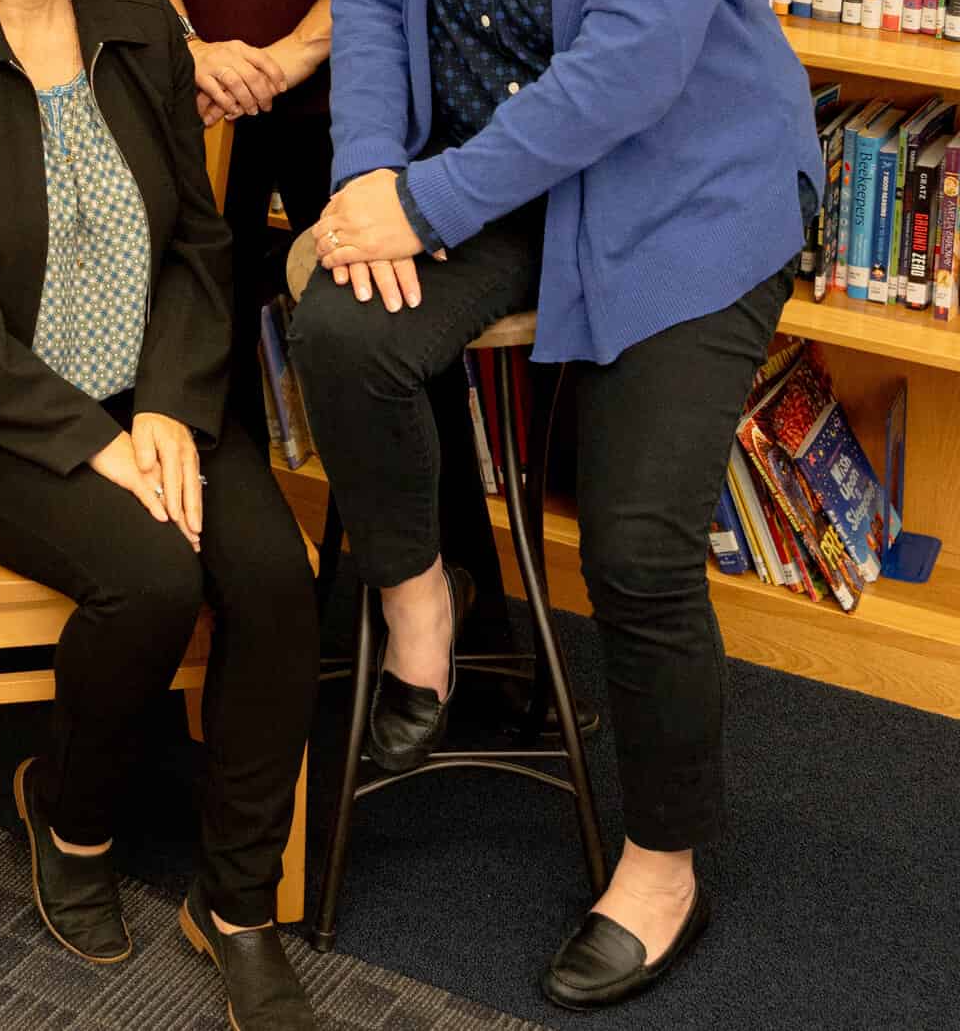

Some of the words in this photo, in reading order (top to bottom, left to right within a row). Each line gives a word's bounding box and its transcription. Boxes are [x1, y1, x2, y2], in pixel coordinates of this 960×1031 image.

[854, 152, 874, 226] Beekeepers
[918, 172, 928, 200] GRATZ
[912, 213, 929, 251] GROUND
[910, 251, 927, 277] ZERO
